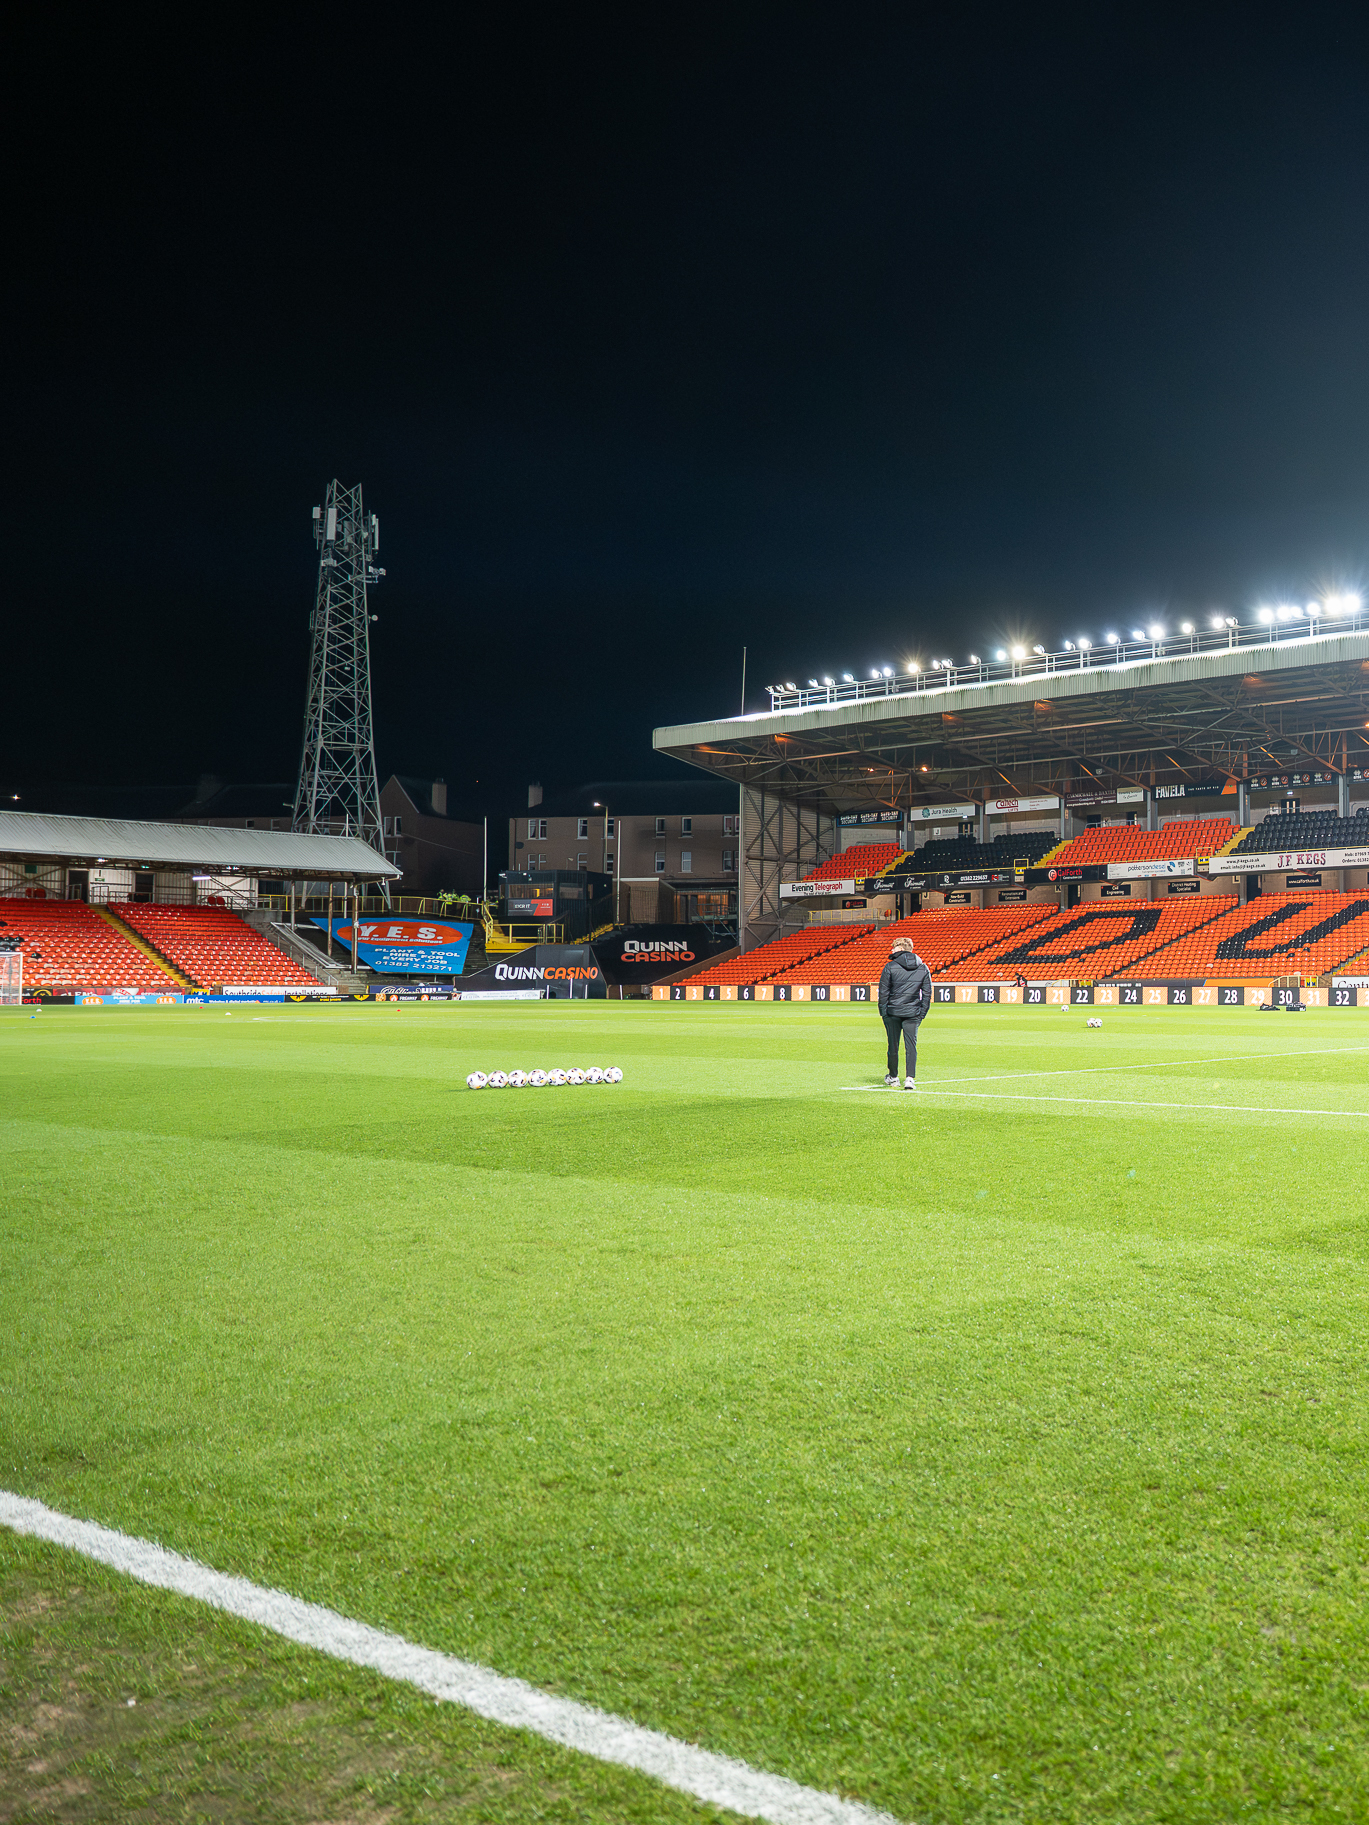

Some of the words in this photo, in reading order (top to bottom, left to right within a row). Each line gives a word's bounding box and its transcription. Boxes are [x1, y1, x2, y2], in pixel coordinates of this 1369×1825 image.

[1155, 784, 1185, 799] FAVELA
[931, 808, 941, 816] Jura
[941, 806, 958, 814] Health
[1296, 853, 1327, 865] KEGS
[1058, 868, 1082, 877] CalForth
[792, 884, 814, 892] Evening
[814, 882, 843, 891] Telegraph
[1288, 877, 1319, 885] www.calforth.co.uk
[624, 940, 687, 954] QUINN
[621, 951, 696, 962] CASINO
[412, 963, 452, 971] 213271
[659, 988, 664, 999] 1
[675, 988, 680, 999] 2
[692, 988, 697, 999] 3
[708, 988, 714, 999] 4
[726, 988, 731, 999] 5
[743, 988, 749, 999] 6
[761, 988, 767, 999] 7
[779, 988, 785, 999] 8
[798, 988, 804, 999] 9
[816, 988, 826, 999] 10
[836, 988, 845, 999] 11
[855, 988, 865, 999] 12
[939, 989, 950, 1001] 16
[961, 989, 972, 1001] 17
[983, 989, 995, 1001] 18
[1006, 989, 1017, 1001] 19
[1028, 989, 1041, 1002] 20
[1052, 989, 1064, 1002] 21
[1076, 989, 1088, 1002] 22
[1100, 989, 1113, 1002] 23
[1124, 989, 1137, 1002] 24
[1149, 989, 1162, 1002] 25
[1174, 989, 1187, 1003] 26
[1199, 989, 1212, 1003] 27
[1224, 989, 1238, 1003] 28
[1251, 990, 1265, 1003] 29
[1279, 990, 1293, 1003] 30
[1307, 990, 1320, 1003] 31
[1335, 990, 1350, 1005] 32
